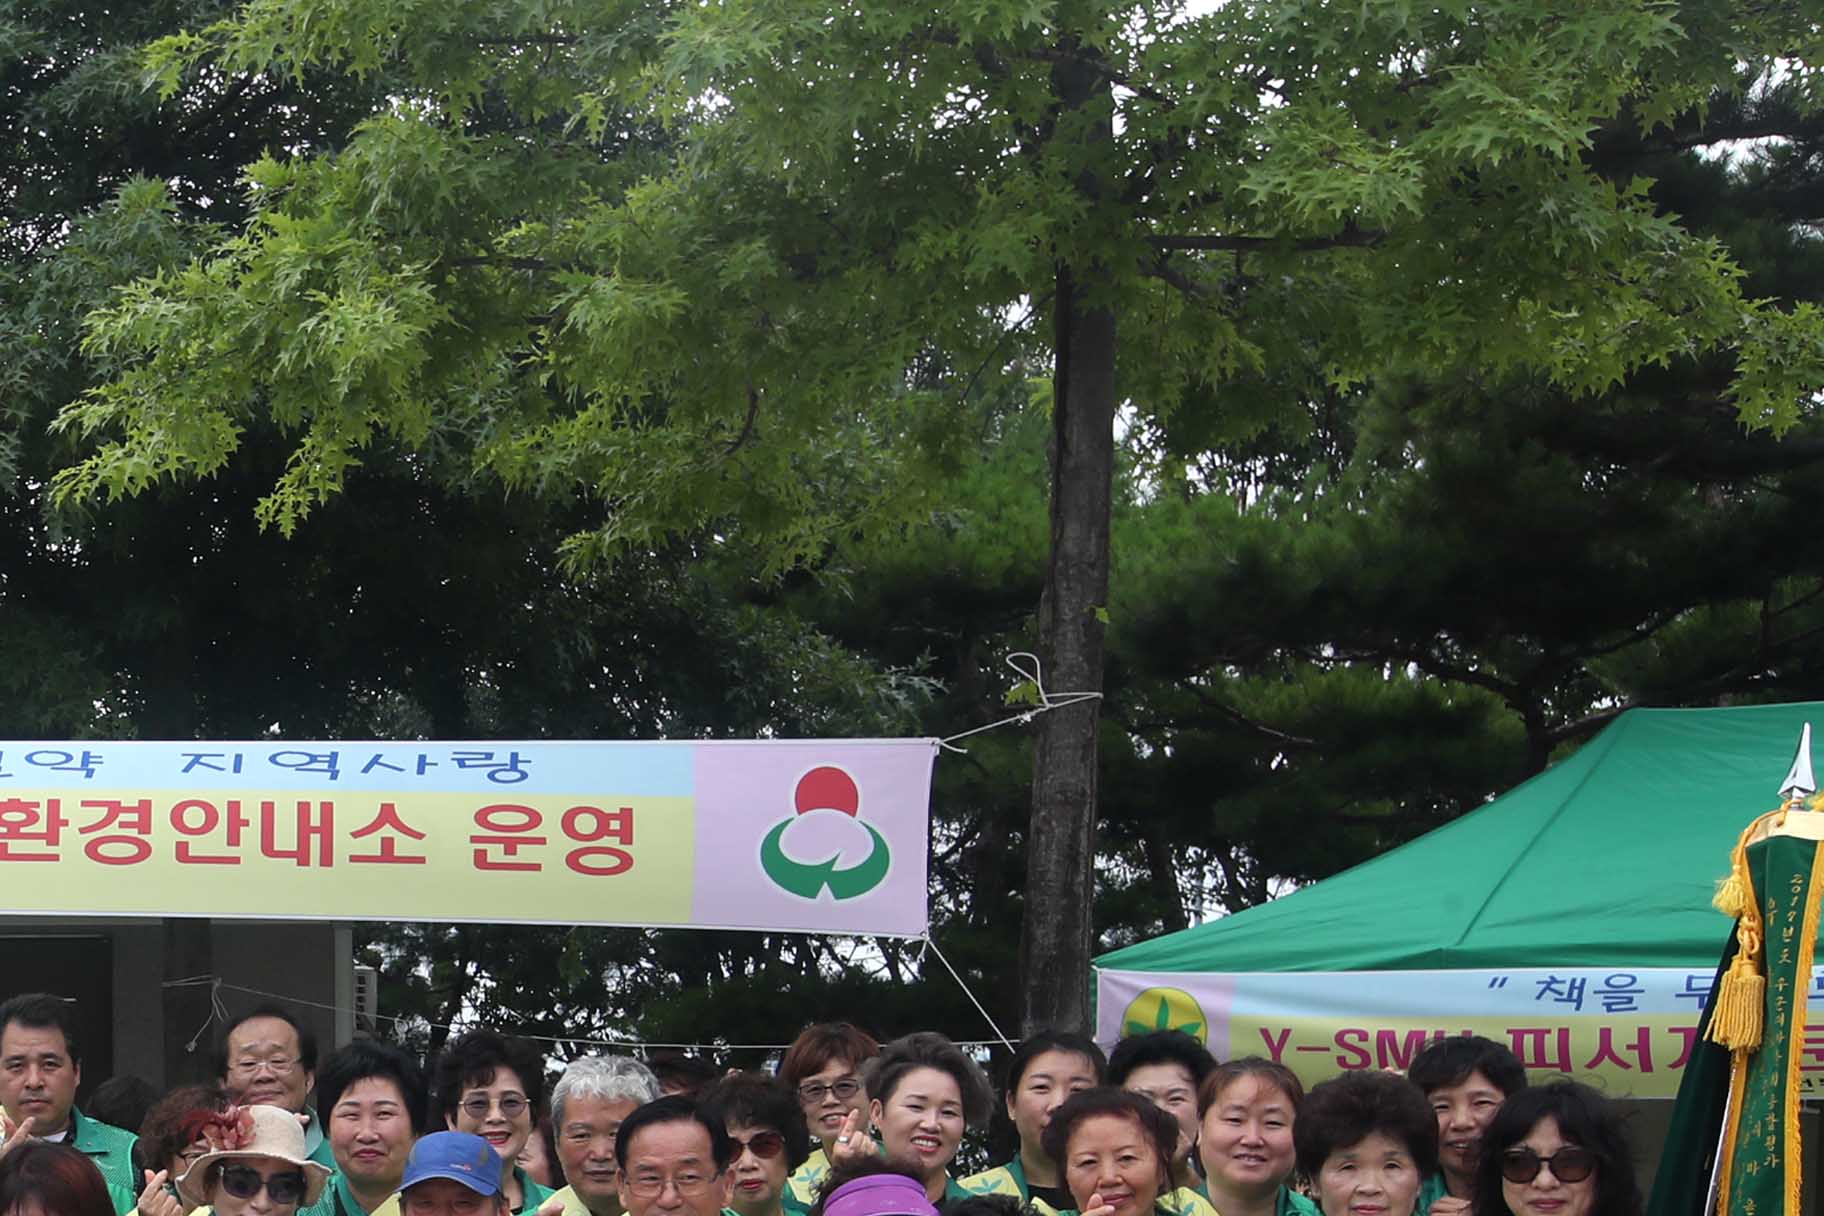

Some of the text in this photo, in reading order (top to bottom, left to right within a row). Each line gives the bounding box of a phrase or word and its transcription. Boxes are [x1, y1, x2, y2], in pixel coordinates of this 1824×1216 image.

[180, 751, 531, 785] 지역사랑
[471, 805, 635, 876] 운영
[1258, 1027, 1444, 1070] Y-SM
